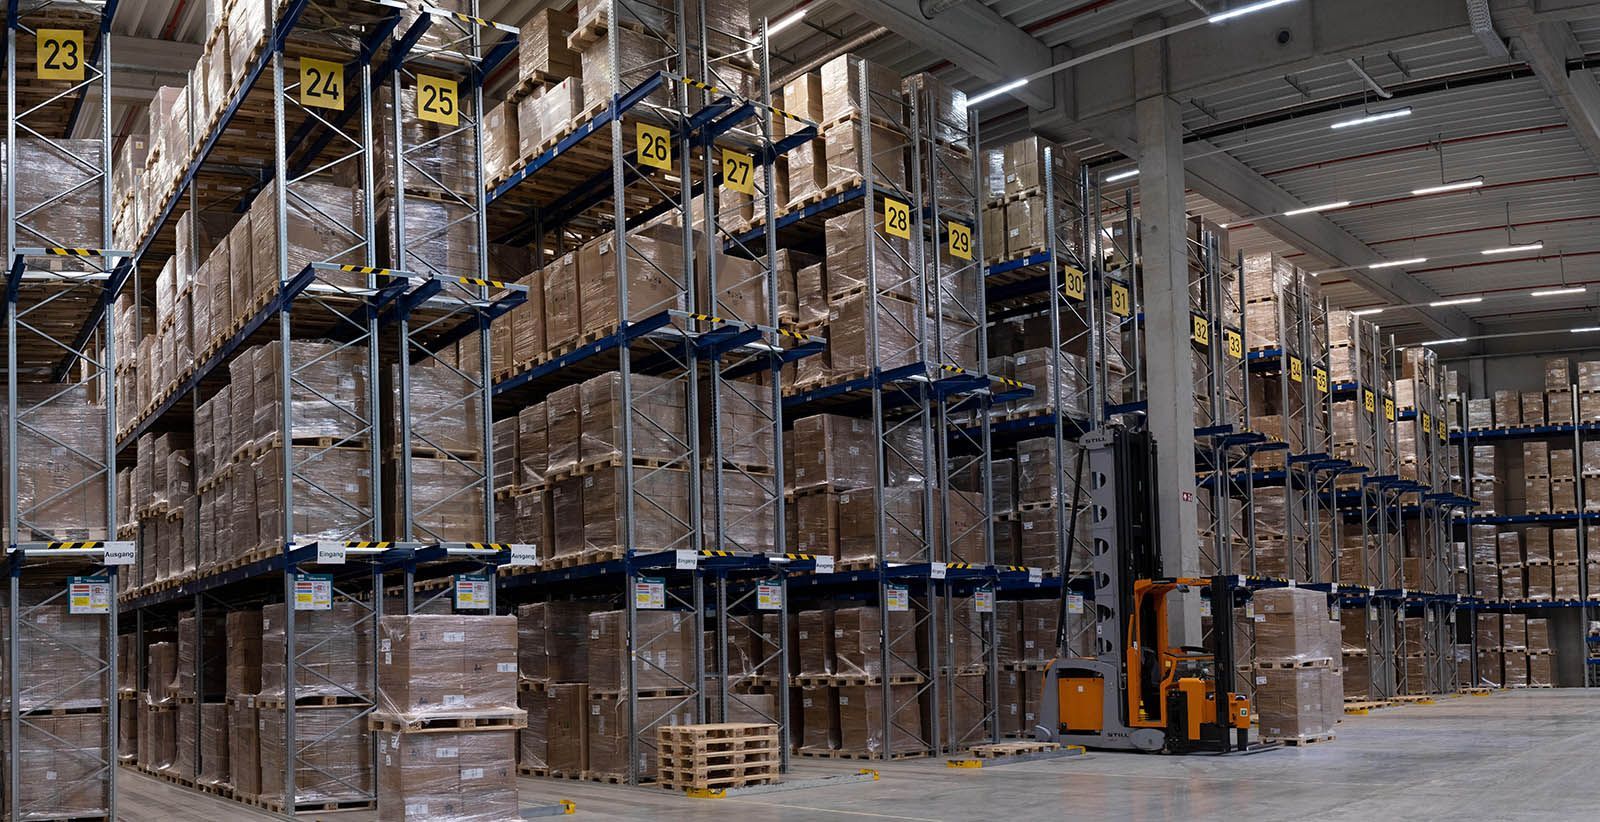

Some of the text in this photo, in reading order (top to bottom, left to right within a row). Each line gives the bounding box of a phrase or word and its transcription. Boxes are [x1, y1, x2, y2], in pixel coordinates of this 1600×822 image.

[43, 38, 79, 70] 23
[306, 67, 340, 100] 24
[422, 84, 454, 116] 25
[642, 132, 667, 161] 26
[726, 158, 749, 185] 27
[888, 206, 907, 231] 28
[951, 229, 969, 253] 29
[1067, 272, 1082, 294] 30
[1114, 290, 1126, 310] 31
[1195, 321, 1207, 340] 32
[1230, 336, 1240, 353] 33
[1292, 361, 1301, 376] 34
[1317, 373, 1326, 388] 35
[104, 551, 135, 559] Ausgang
[319, 551, 344, 559] Eingang
[511, 553, 536, 561] Ausgang
